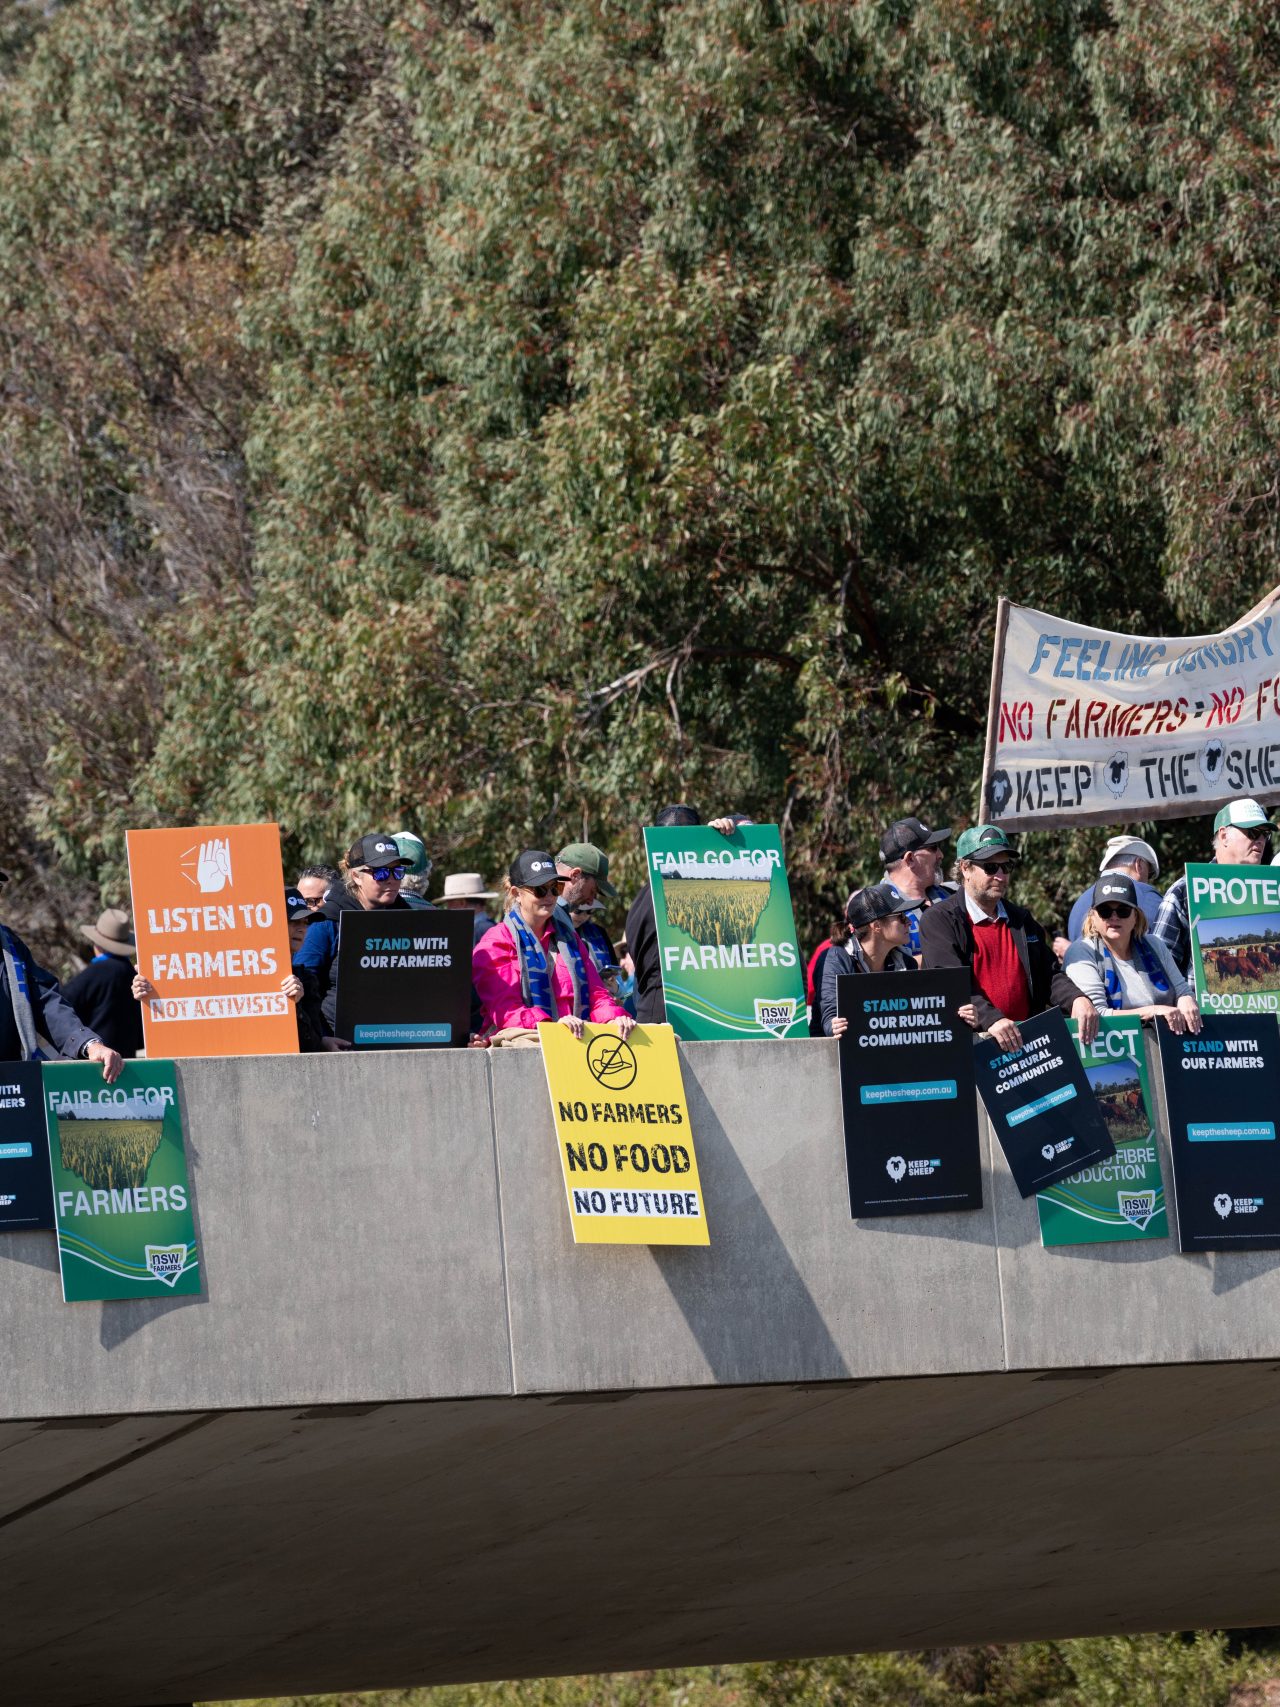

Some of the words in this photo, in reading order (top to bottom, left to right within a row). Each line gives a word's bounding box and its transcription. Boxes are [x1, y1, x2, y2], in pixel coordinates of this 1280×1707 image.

[1029, 634, 1166, 681] FEELING
[999, 701, 1034, 743] NO
[1047, 697, 1188, 739] FARMERS
[1205, 687, 1245, 728] NO
[1016, 765, 1092, 812] KEEP
[1140, 753, 1198, 799] THE
[651, 851, 697, 871] FAIR
[703, 850, 734, 868] GO
[739, 849, 781, 868] FOR
[148, 904, 235, 934] LISTEN
[239, 903, 272, 928] TO
[365, 938, 411, 951] STAND
[413, 937, 448, 950] WITH
[152, 948, 277, 981] FARMERS
[360, 955, 388, 968] OUR
[390, 954, 452, 968] FARMERS
[664, 942, 796, 972] FARMERS
[151, 1000, 188, 1020] NOT
[193, 994, 287, 1017] ACTIVISTS
[863, 998, 909, 1013] STAND
[910, 996, 946, 1010] WITH
[1200, 993, 1243, 1009] FOOD
[1246, 994, 1278, 1010] AND
[761, 1007, 789, 1018] nsw
[762, 1016, 791, 1025] FARMERS
[869, 1016, 898, 1030] OUR
[899, 1013, 942, 1028] RURAL
[359, 1029, 447, 1039] keepthesheep.com.au
[858, 1030, 953, 1047] COMMUNITIES
[989, 1047, 1023, 1070] STAND
[1023, 1034, 1050, 1053] WITH
[1072, 1029, 1139, 1059] TECT
[1182, 1040, 1224, 1053] STAND
[1225, 1039, 1258, 1052] WITH
[998, 1061, 1020, 1079] OUR
[1019, 1050, 1052, 1069] RURAL
[1181, 1057, 1207, 1070] OUR
[1208, 1056, 1265, 1069] FARMERS
[995, 1056, 1064, 1094] COMMUNITIES
[49, 1091, 92, 1112] FAIR
[98, 1088, 128, 1109] GO
[133, 1086, 175, 1107] FOR
[865, 1086, 952, 1100] keepthesheep.com.au
[558, 1101, 588, 1122] NO
[591, 1102, 683, 1125] FARMERS
[1192, 1126, 1271, 1138] keepthesheep.com.au
[565, 1142, 608, 1172] NO
[613, 1143, 691, 1174] FOOD
[908, 1159, 929, 1168] KEEP
[1116, 1147, 1156, 1164] FIBRE
[908, 1167, 935, 1176] SHEEP
[1062, 1165, 1146, 1185] ODUCTION
[58, 1184, 188, 1217] FARMERS
[573, 1190, 606, 1214] NO
[610, 1191, 699, 1216] FUTURE
[1124, 1198, 1149, 1210] nsw
[1234, 1198, 1253, 1206] KEEP
[1125, 1208, 1151, 1217] FARMERS
[1234, 1205, 1258, 1214] SHEEP
[152, 1252, 179, 1265] nsw
[153, 1264, 182, 1273] FARMERS
